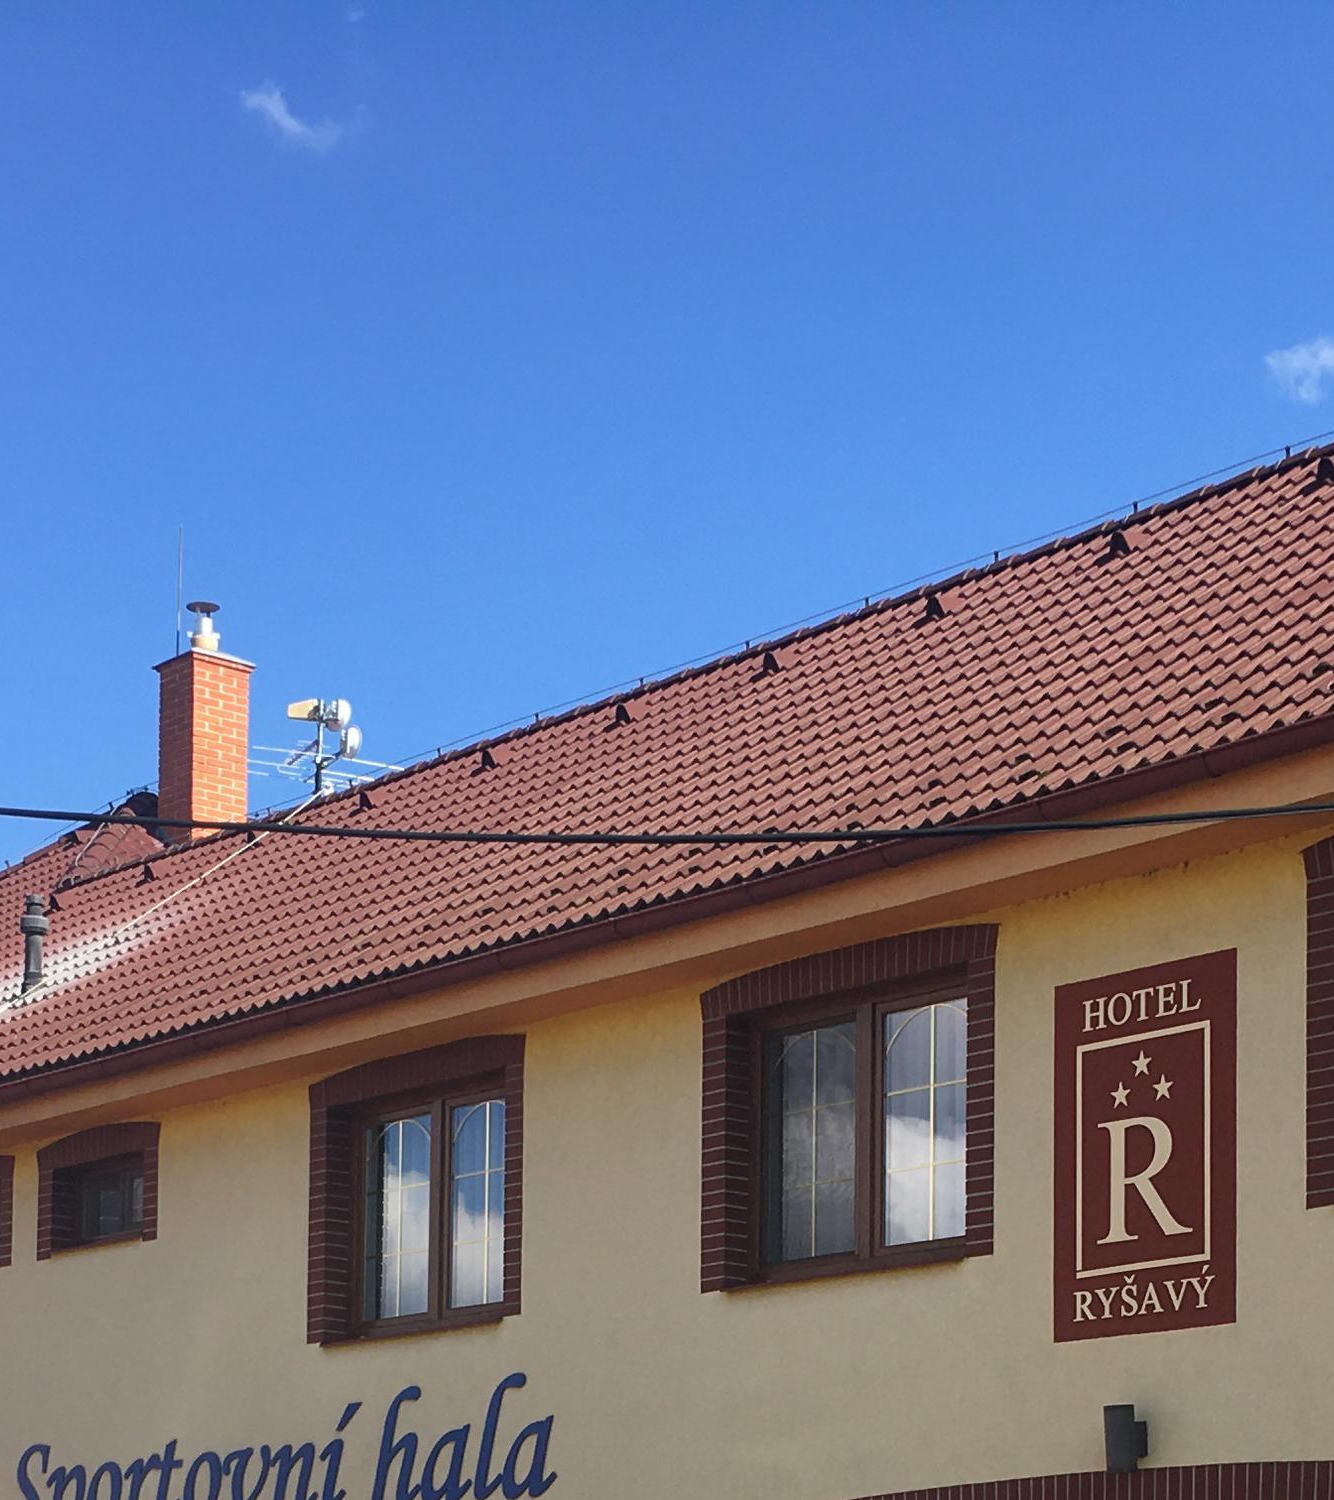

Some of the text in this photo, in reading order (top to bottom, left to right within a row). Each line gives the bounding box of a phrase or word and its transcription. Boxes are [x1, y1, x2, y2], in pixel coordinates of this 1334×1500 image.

[1081, 979, 1202, 1033] HOTEL
[1097, 1116, 1193, 1245] R
[1073, 1265, 1215, 1323] RYŠAVÝ
